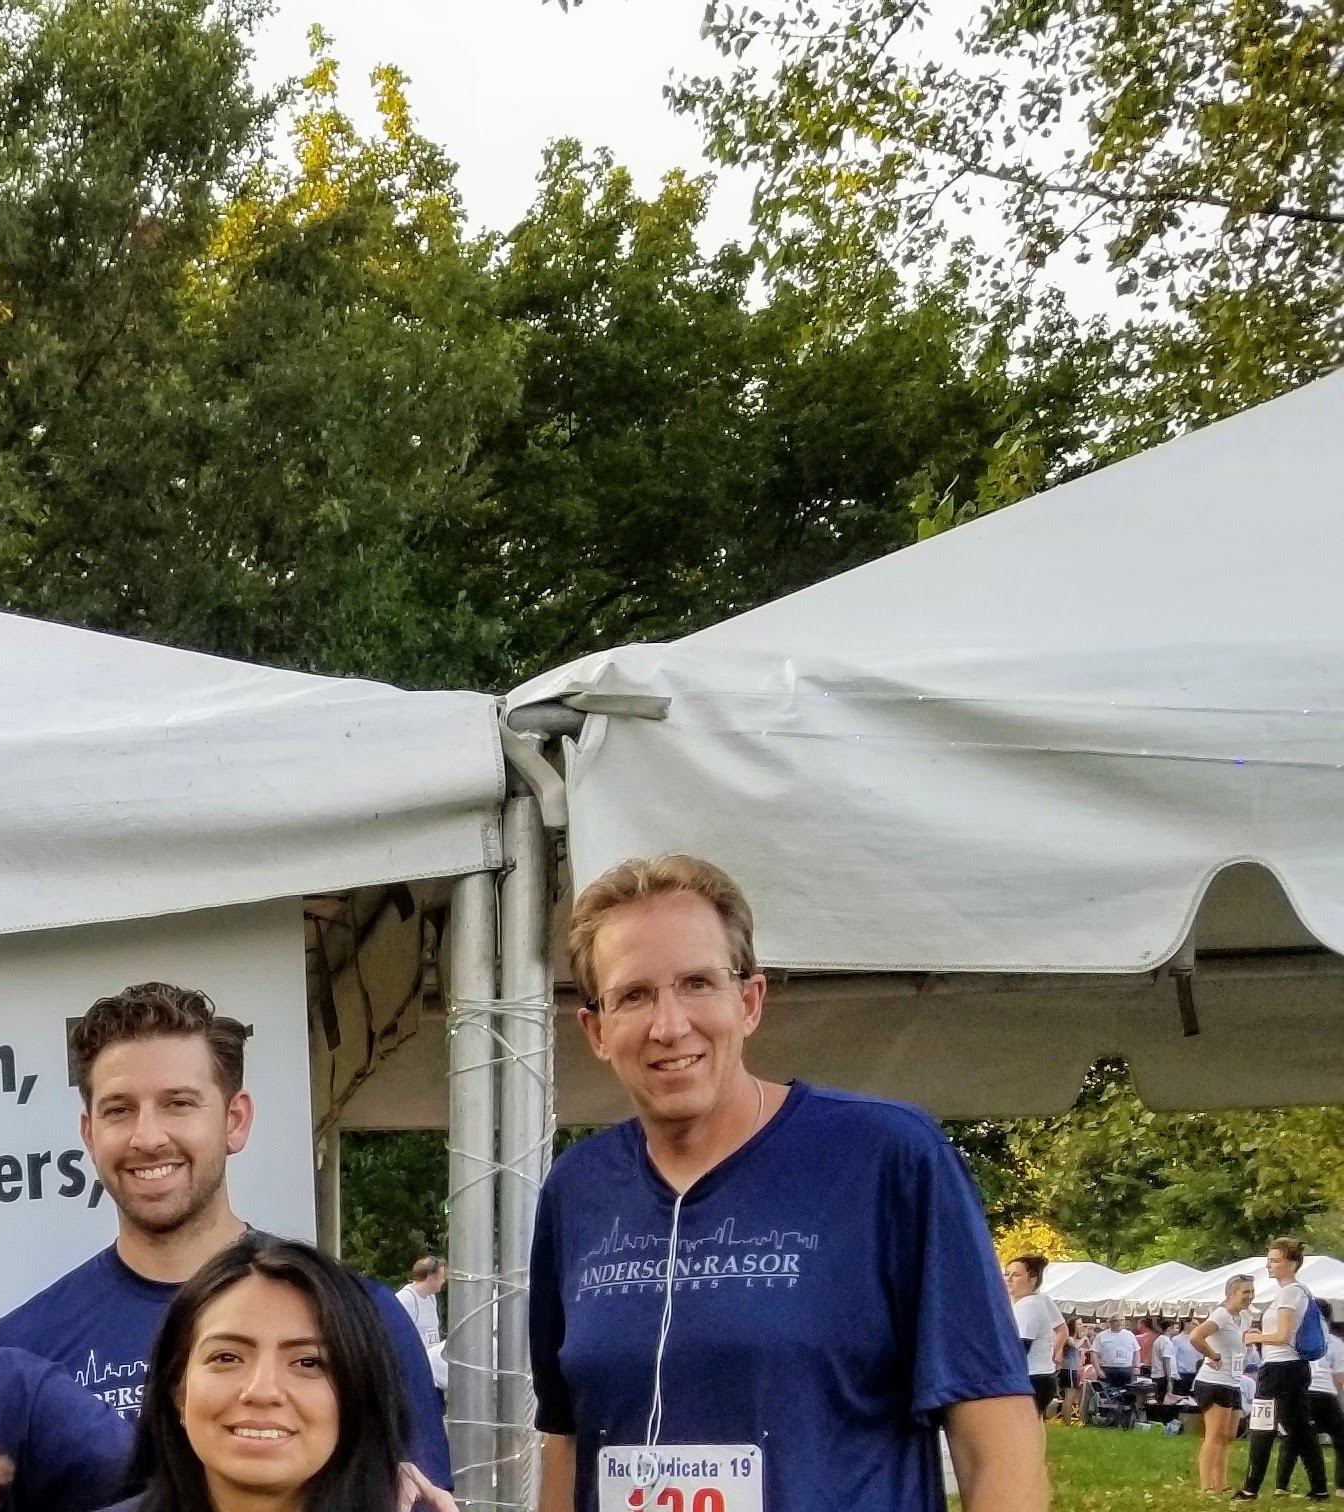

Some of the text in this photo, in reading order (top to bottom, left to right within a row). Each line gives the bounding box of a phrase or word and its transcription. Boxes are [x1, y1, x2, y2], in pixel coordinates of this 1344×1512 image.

[580, 1253, 800, 1286] ANDERSON RASOR
[746, 1278, 797, 1288] LLP
[650, 1457, 719, 1478] udicata
[730, 1458, 751, 1478] 19
